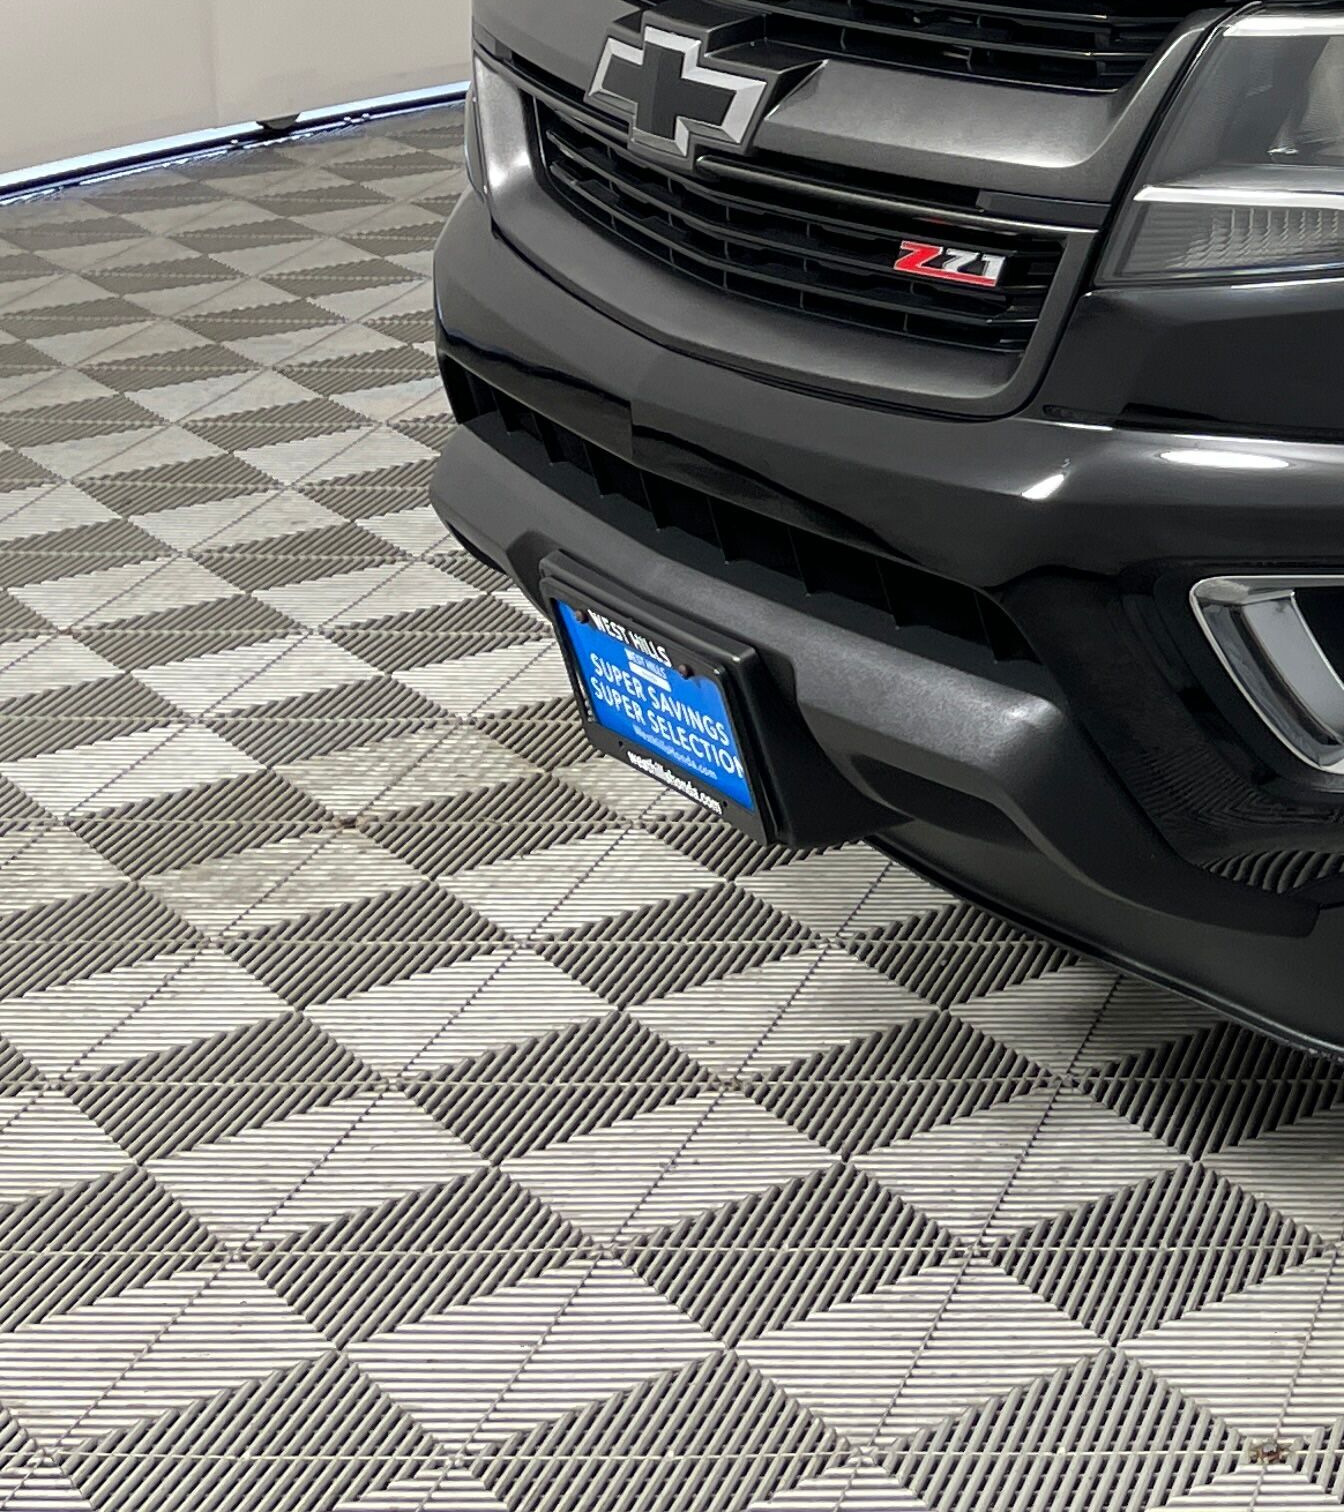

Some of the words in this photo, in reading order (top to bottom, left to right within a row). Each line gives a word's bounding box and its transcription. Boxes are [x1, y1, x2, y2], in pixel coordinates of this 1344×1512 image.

[893, 240, 1006, 287] Z71
[587, 609, 630, 644] WEST
[628, 630, 672, 668] HILLS
[590, 652, 646, 702] SUPER
[647, 686, 730, 747] SAVINGS
[590, 676, 646, 726] SUPER
